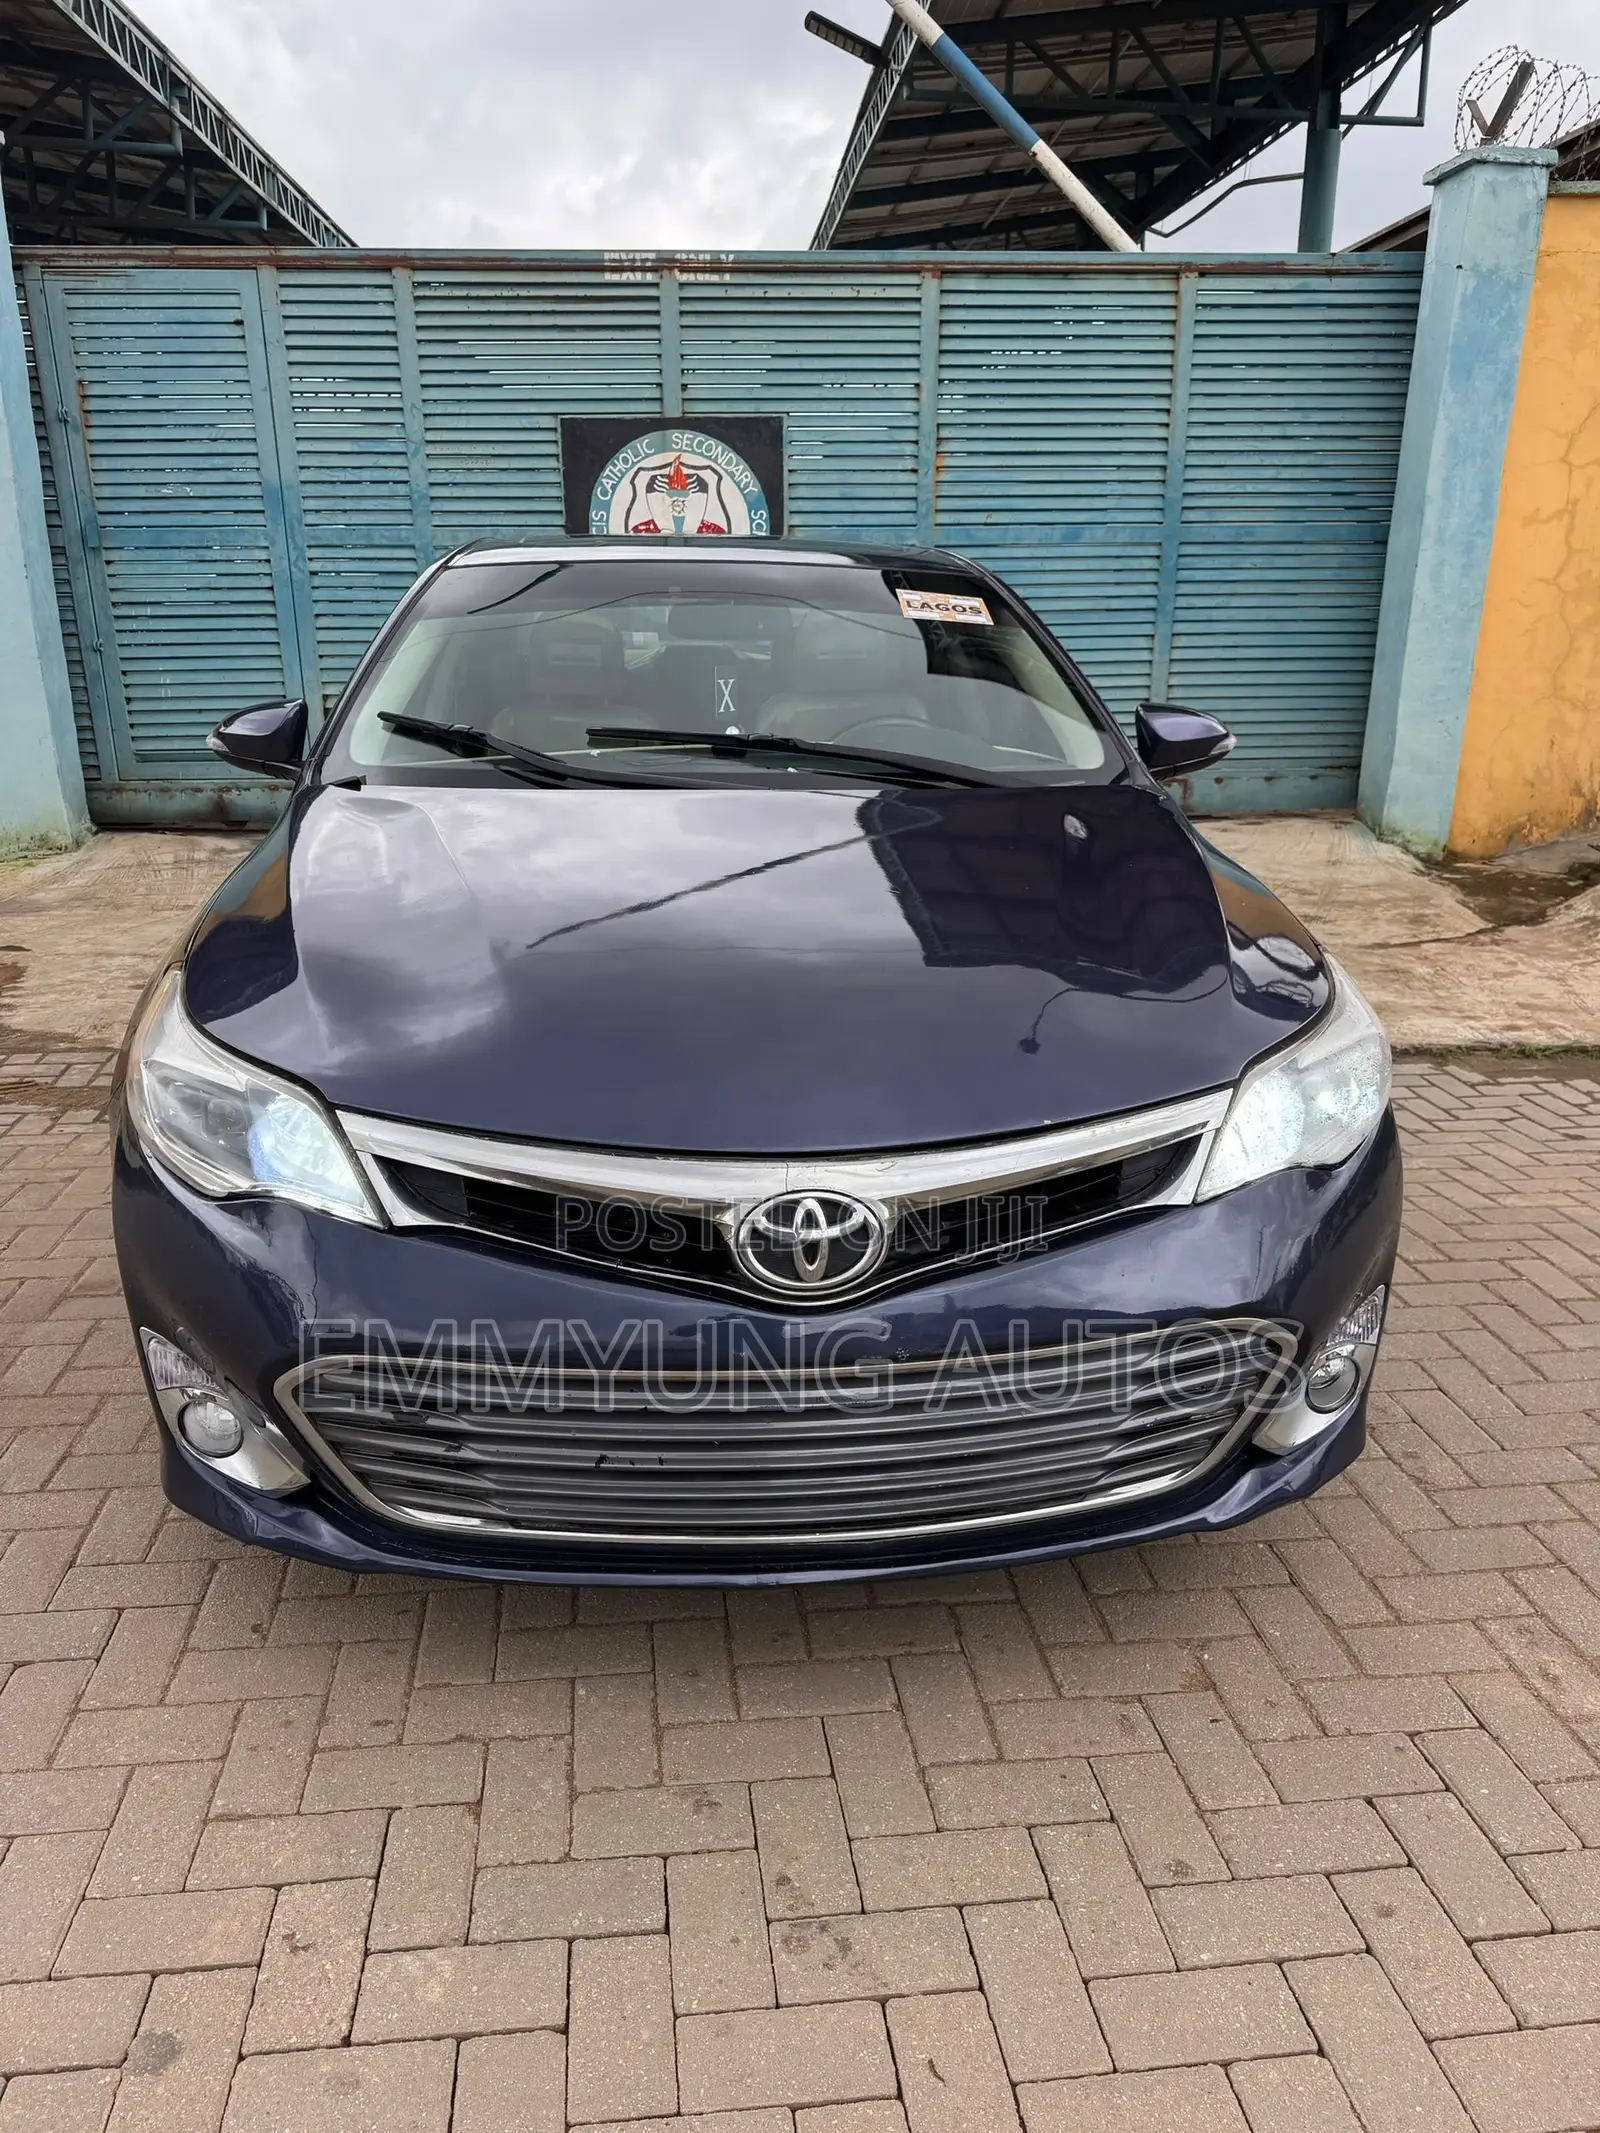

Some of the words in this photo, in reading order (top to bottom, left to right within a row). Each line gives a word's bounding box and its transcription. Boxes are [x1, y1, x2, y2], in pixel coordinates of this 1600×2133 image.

[603, 252, 656, 281] EXIT
[674, 253, 735, 281] ONLY
[597, 438, 655, 501] CATHOLIC
[671, 433, 759, 496] SECONDARY
[905, 600, 983, 615] LAGOS
